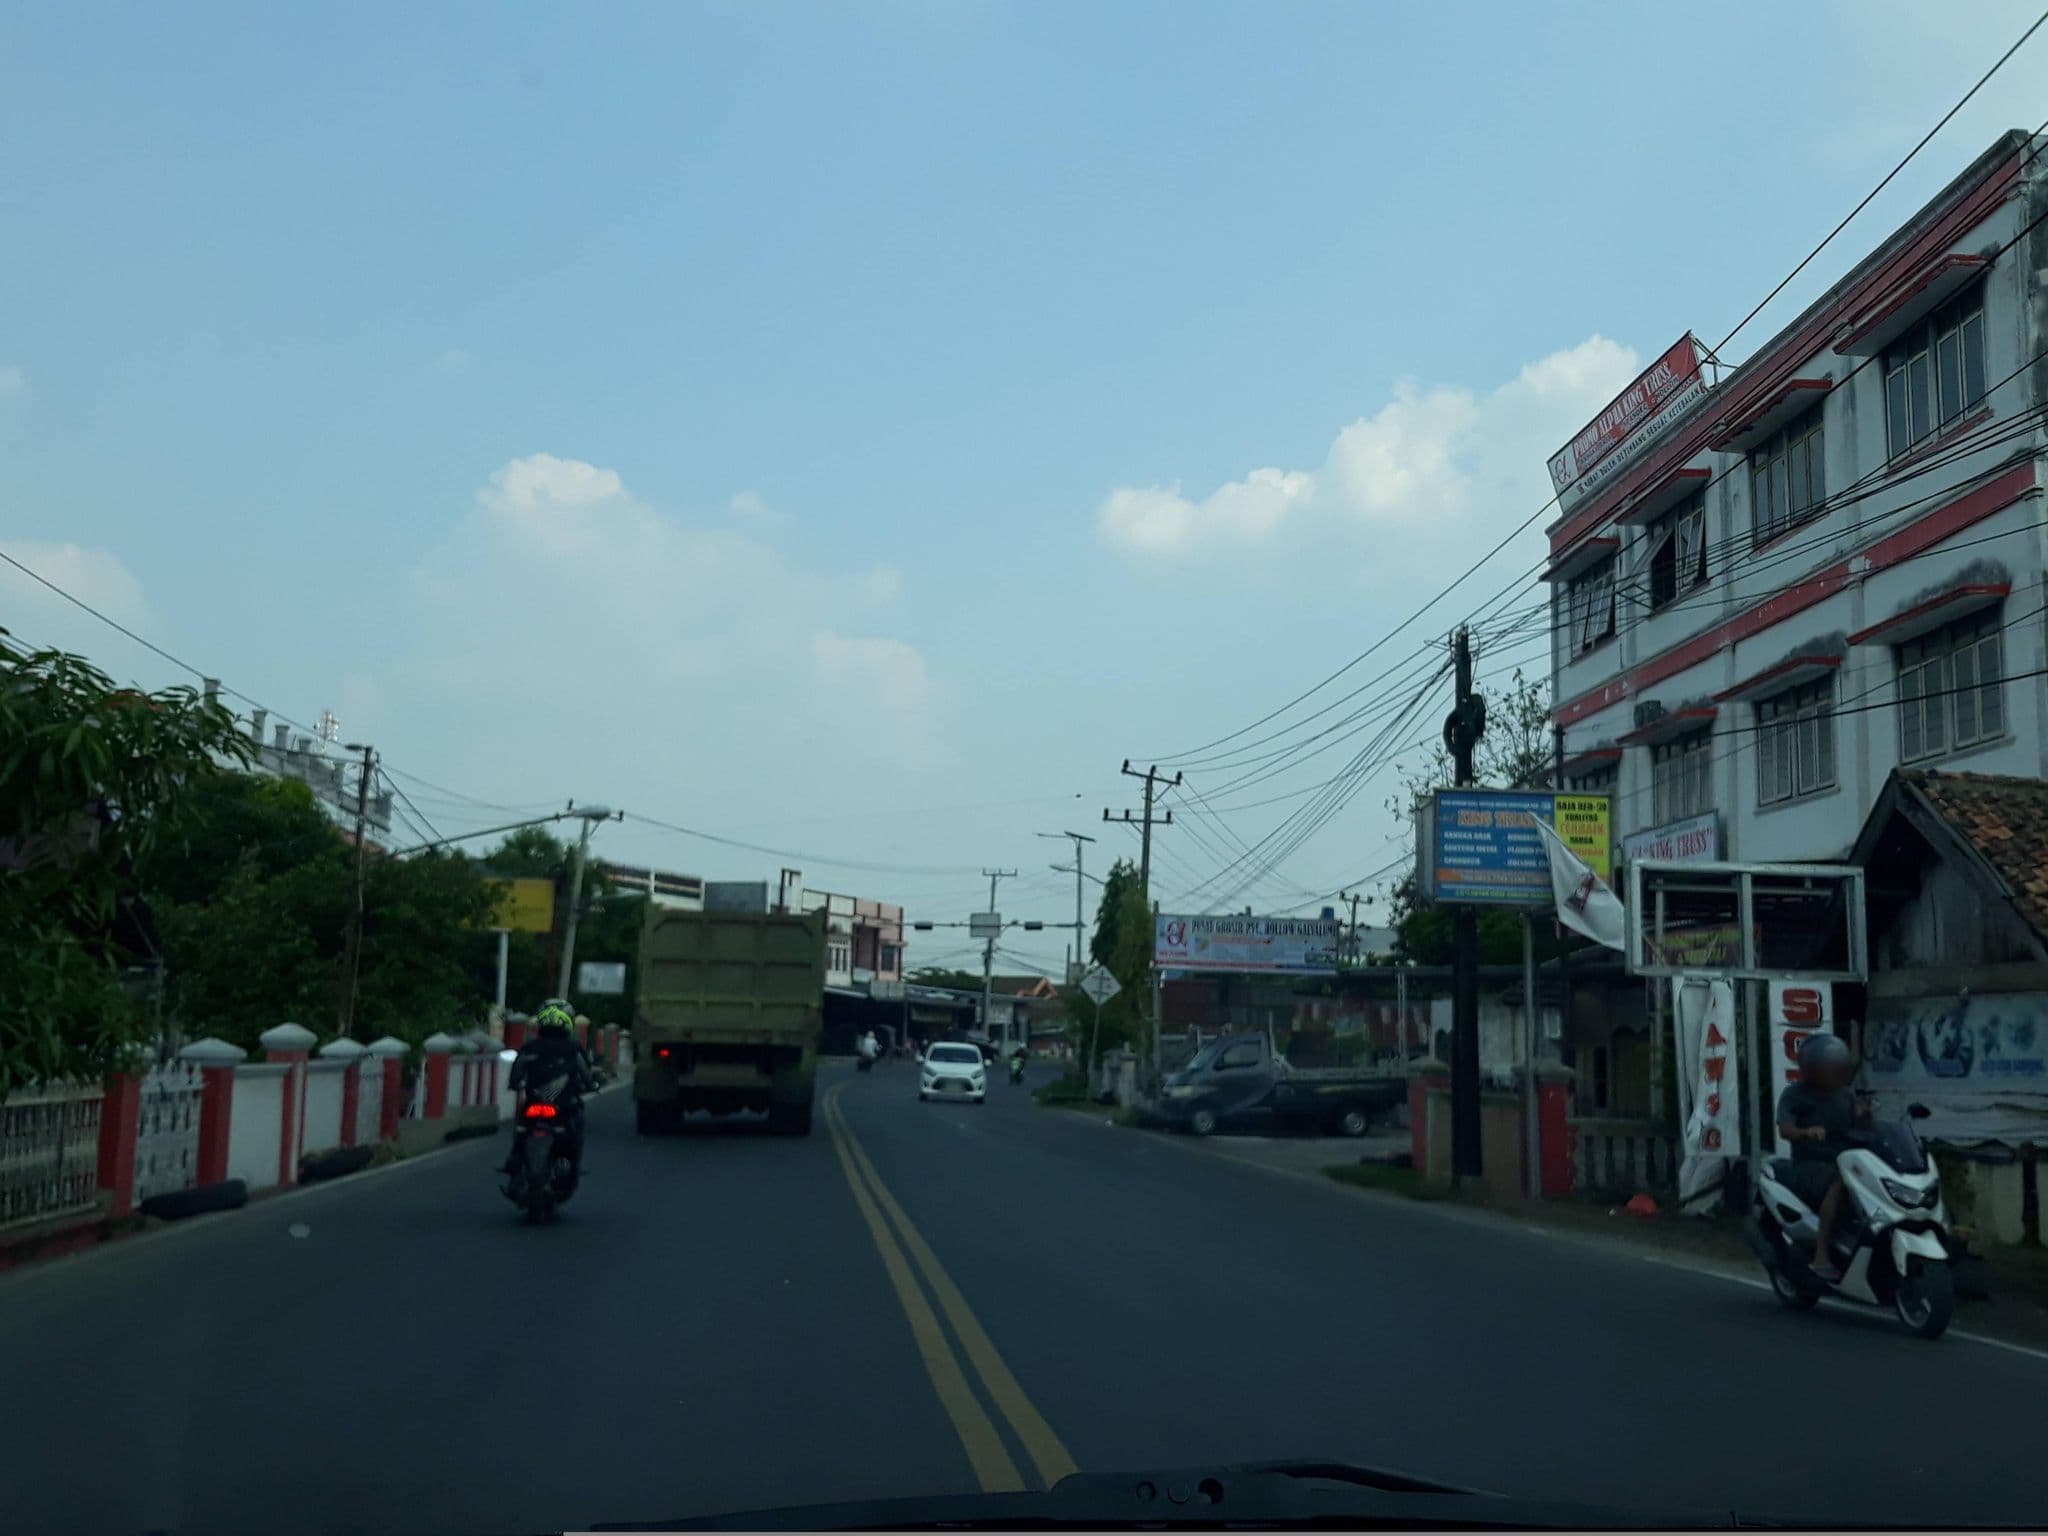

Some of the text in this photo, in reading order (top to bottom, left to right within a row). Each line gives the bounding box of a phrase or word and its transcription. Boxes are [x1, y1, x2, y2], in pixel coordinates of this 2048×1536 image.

[1622, 385, 1644, 417] KING
[1643, 361, 1671, 396] TRUSS
[1216, 919, 1243, 935] GROSIR
